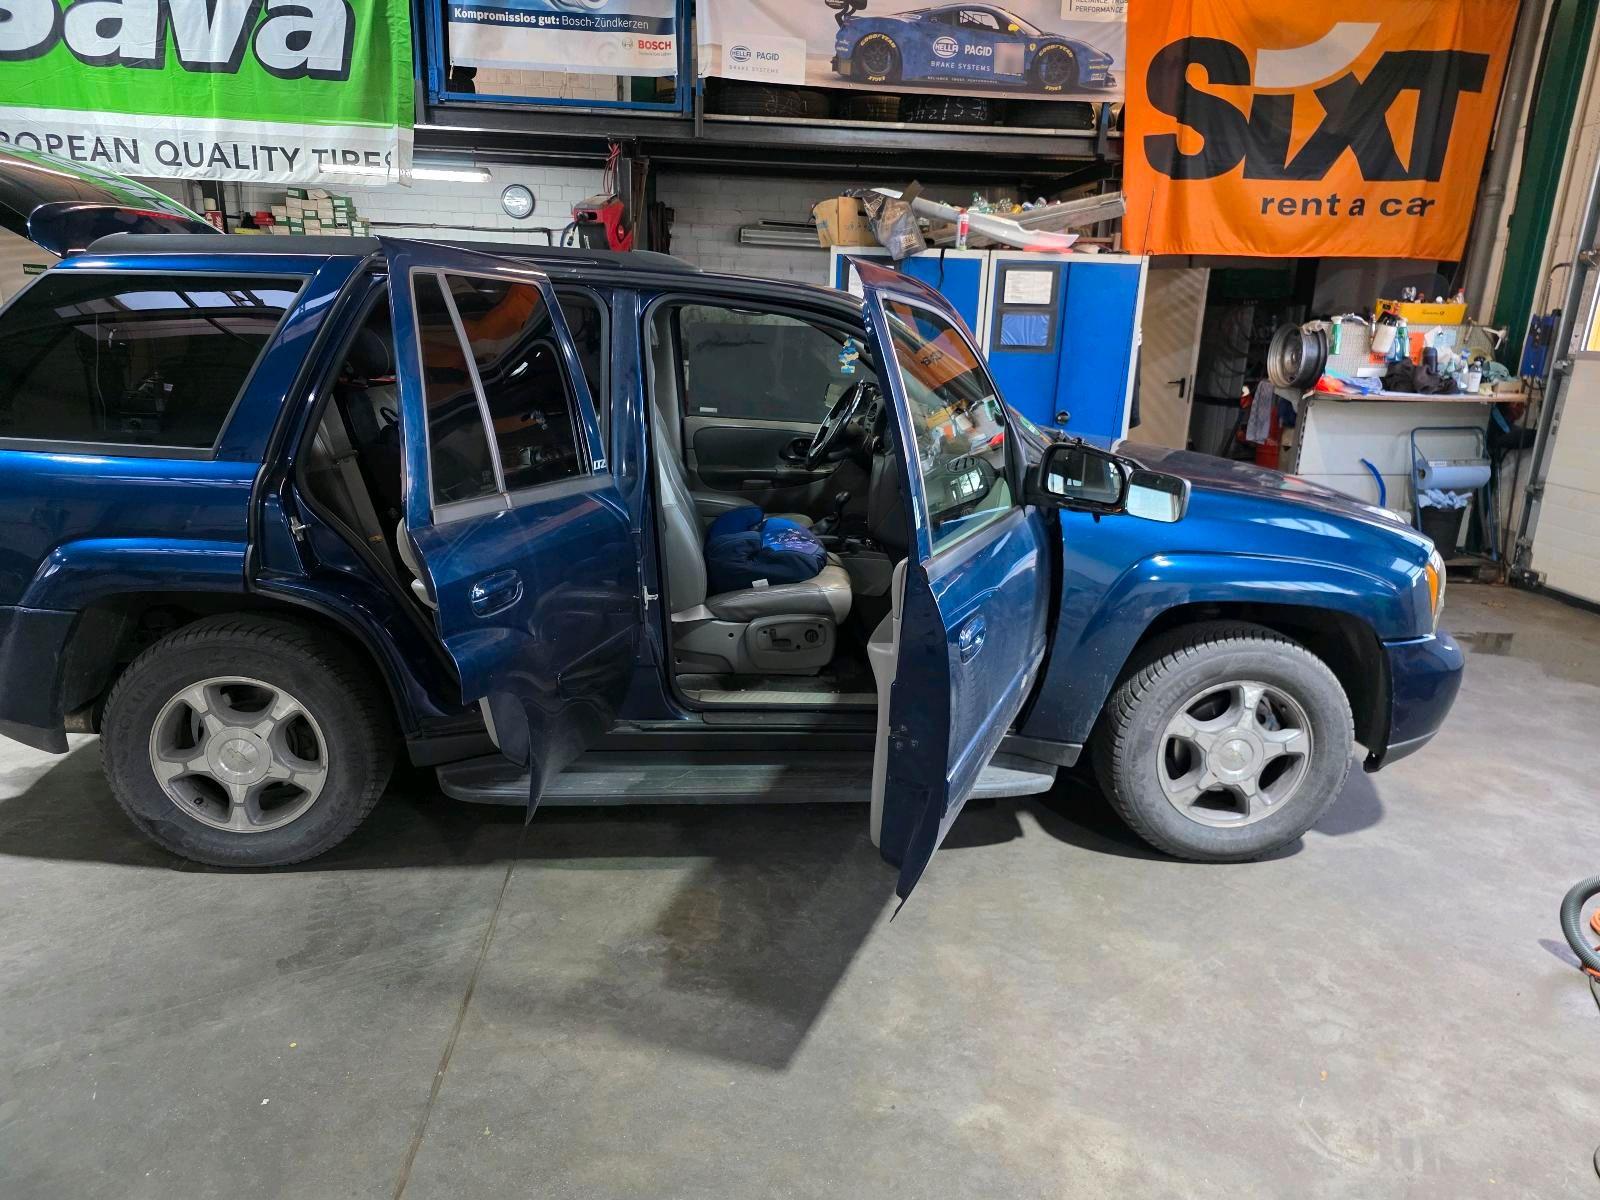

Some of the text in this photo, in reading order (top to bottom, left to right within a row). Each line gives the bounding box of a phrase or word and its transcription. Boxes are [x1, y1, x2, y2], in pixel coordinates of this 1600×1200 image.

[1075, 5, 1124, 14] PERFORMANCE
[454, 7, 649, 30] Kompromisslos gut: Bosch-Zündkerzen
[638, 39, 672, 50] BOSCH
[756, 51, 780, 61] PAGID
[964, 45, 992, 56] PAGID
[930, 60, 991, 72] BRAKE SYSTEMS
[155, 139, 299, 173] QUALITY
[1261, 192, 1437, 218] rent a car
